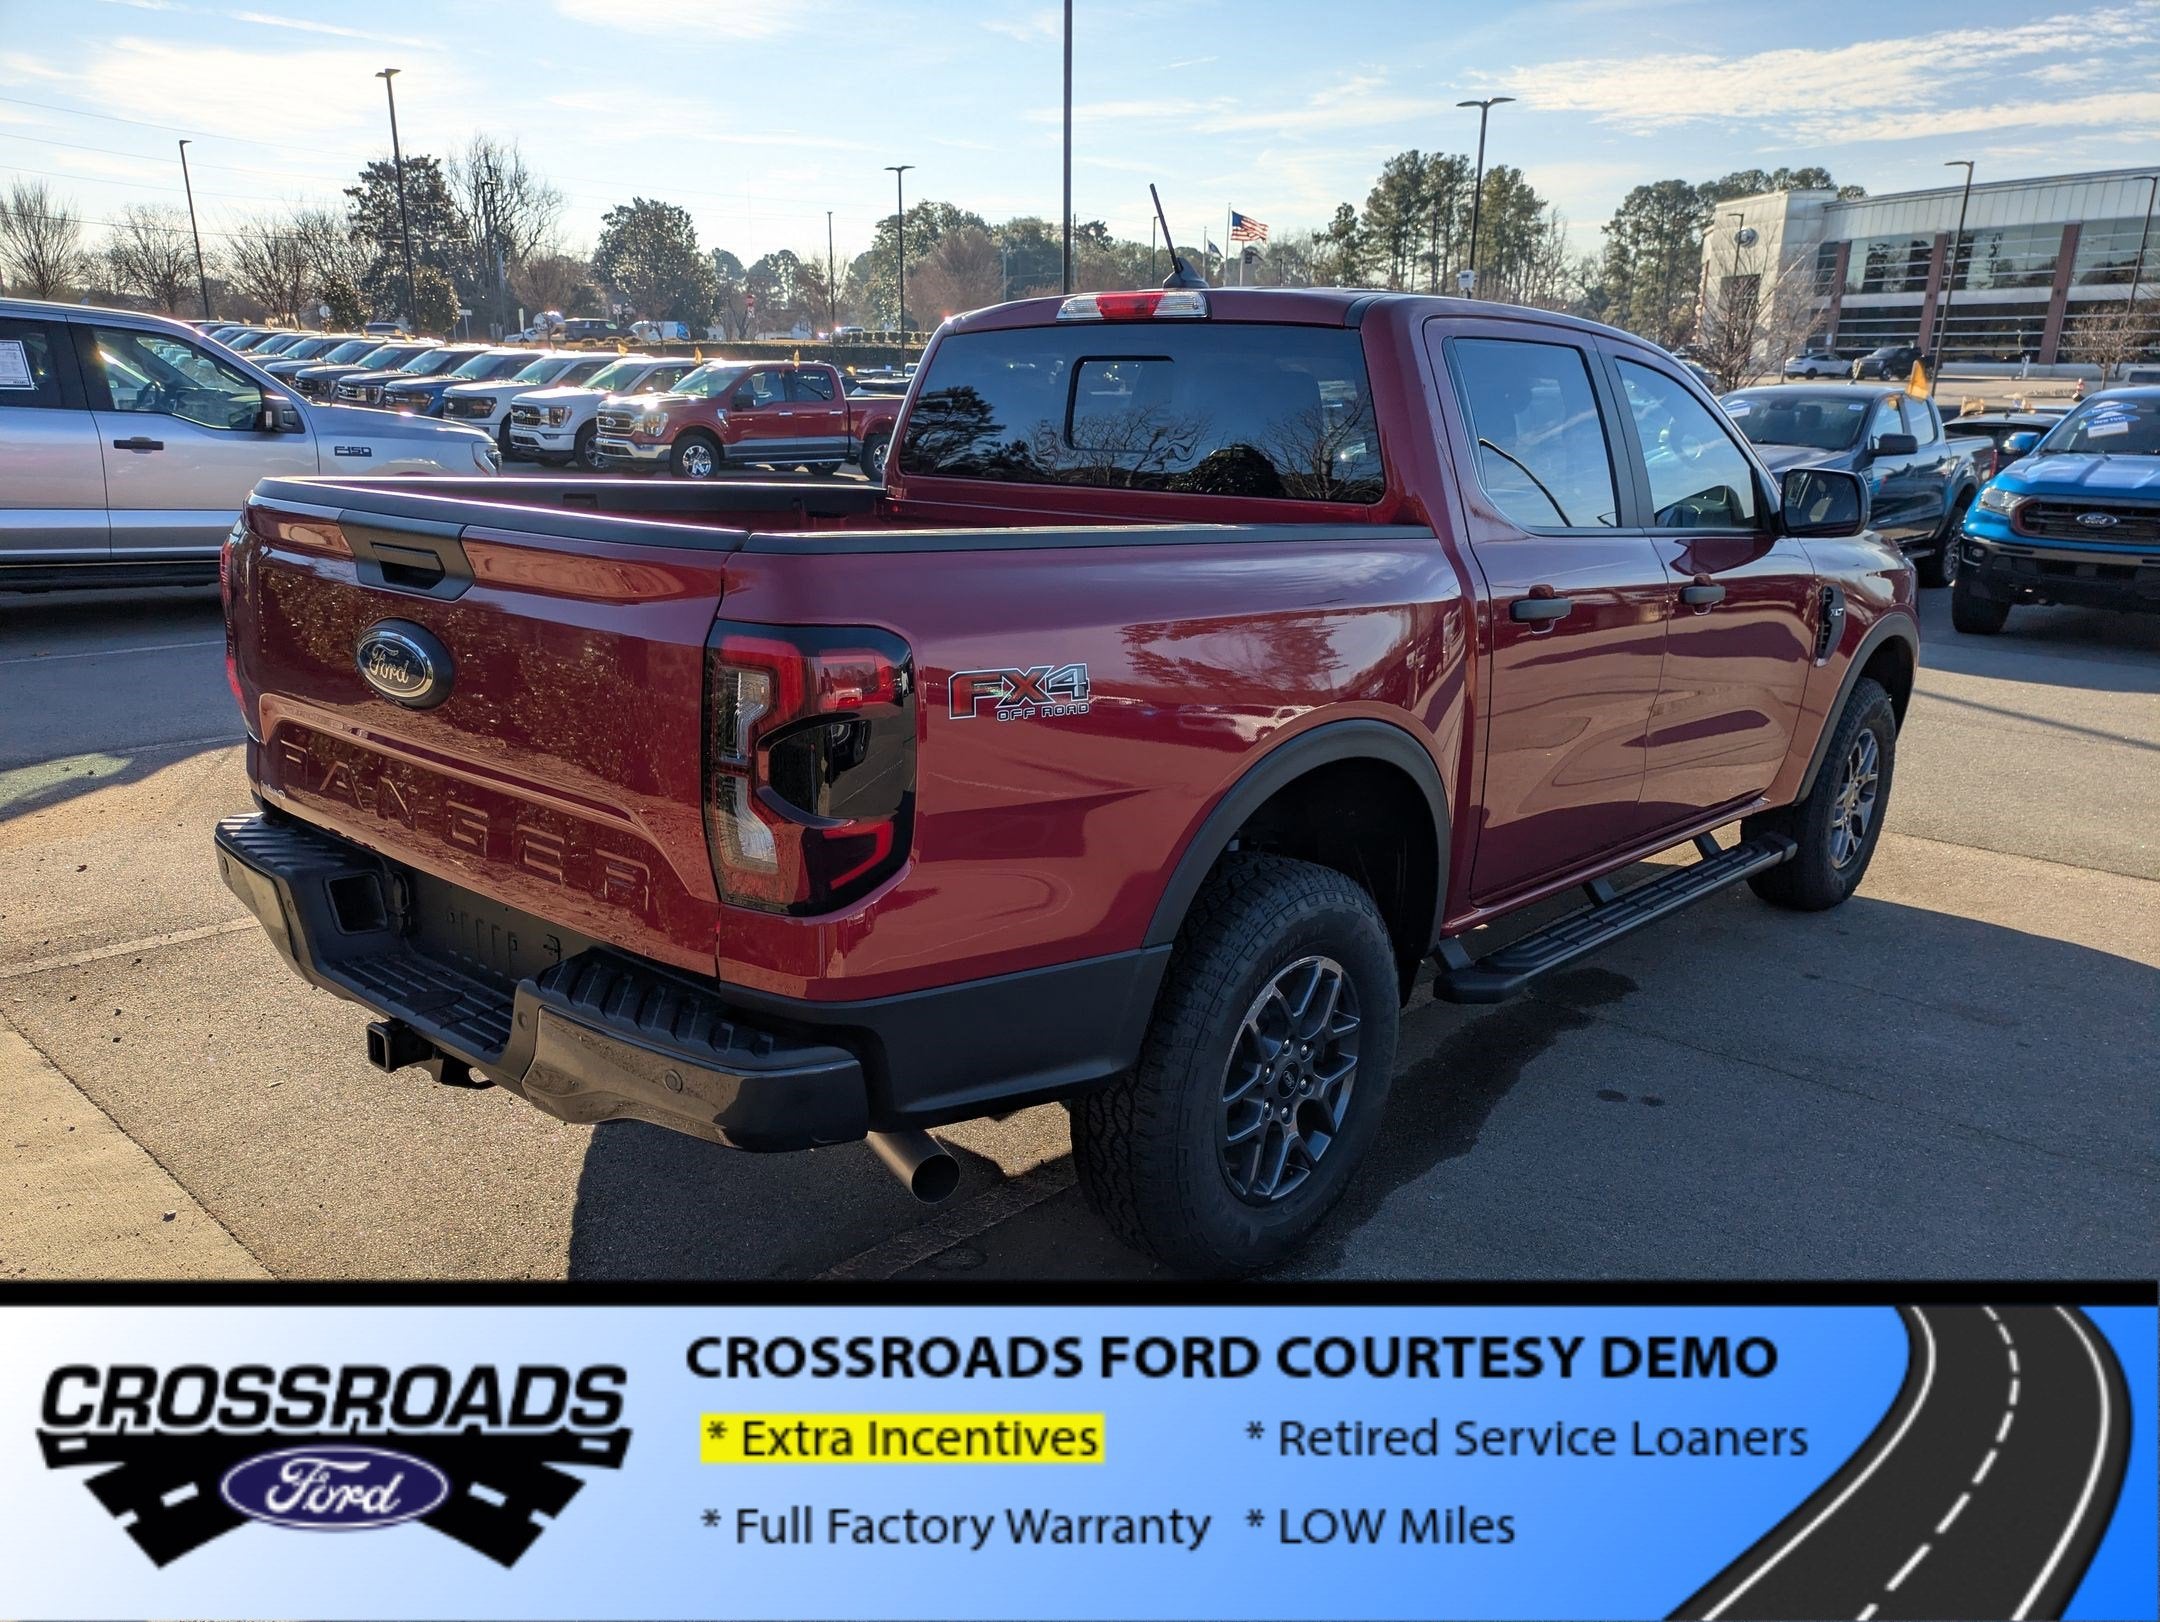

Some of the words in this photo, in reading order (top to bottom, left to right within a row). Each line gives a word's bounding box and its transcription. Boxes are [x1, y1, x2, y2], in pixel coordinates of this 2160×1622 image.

[369, 644, 409, 684] Ford
[948, 663, 1090, 719] FX4
[996, 707, 1036, 722] OFF
[1041, 702, 1090, 718] ROAD
[279, 738, 654, 913] RANGER
